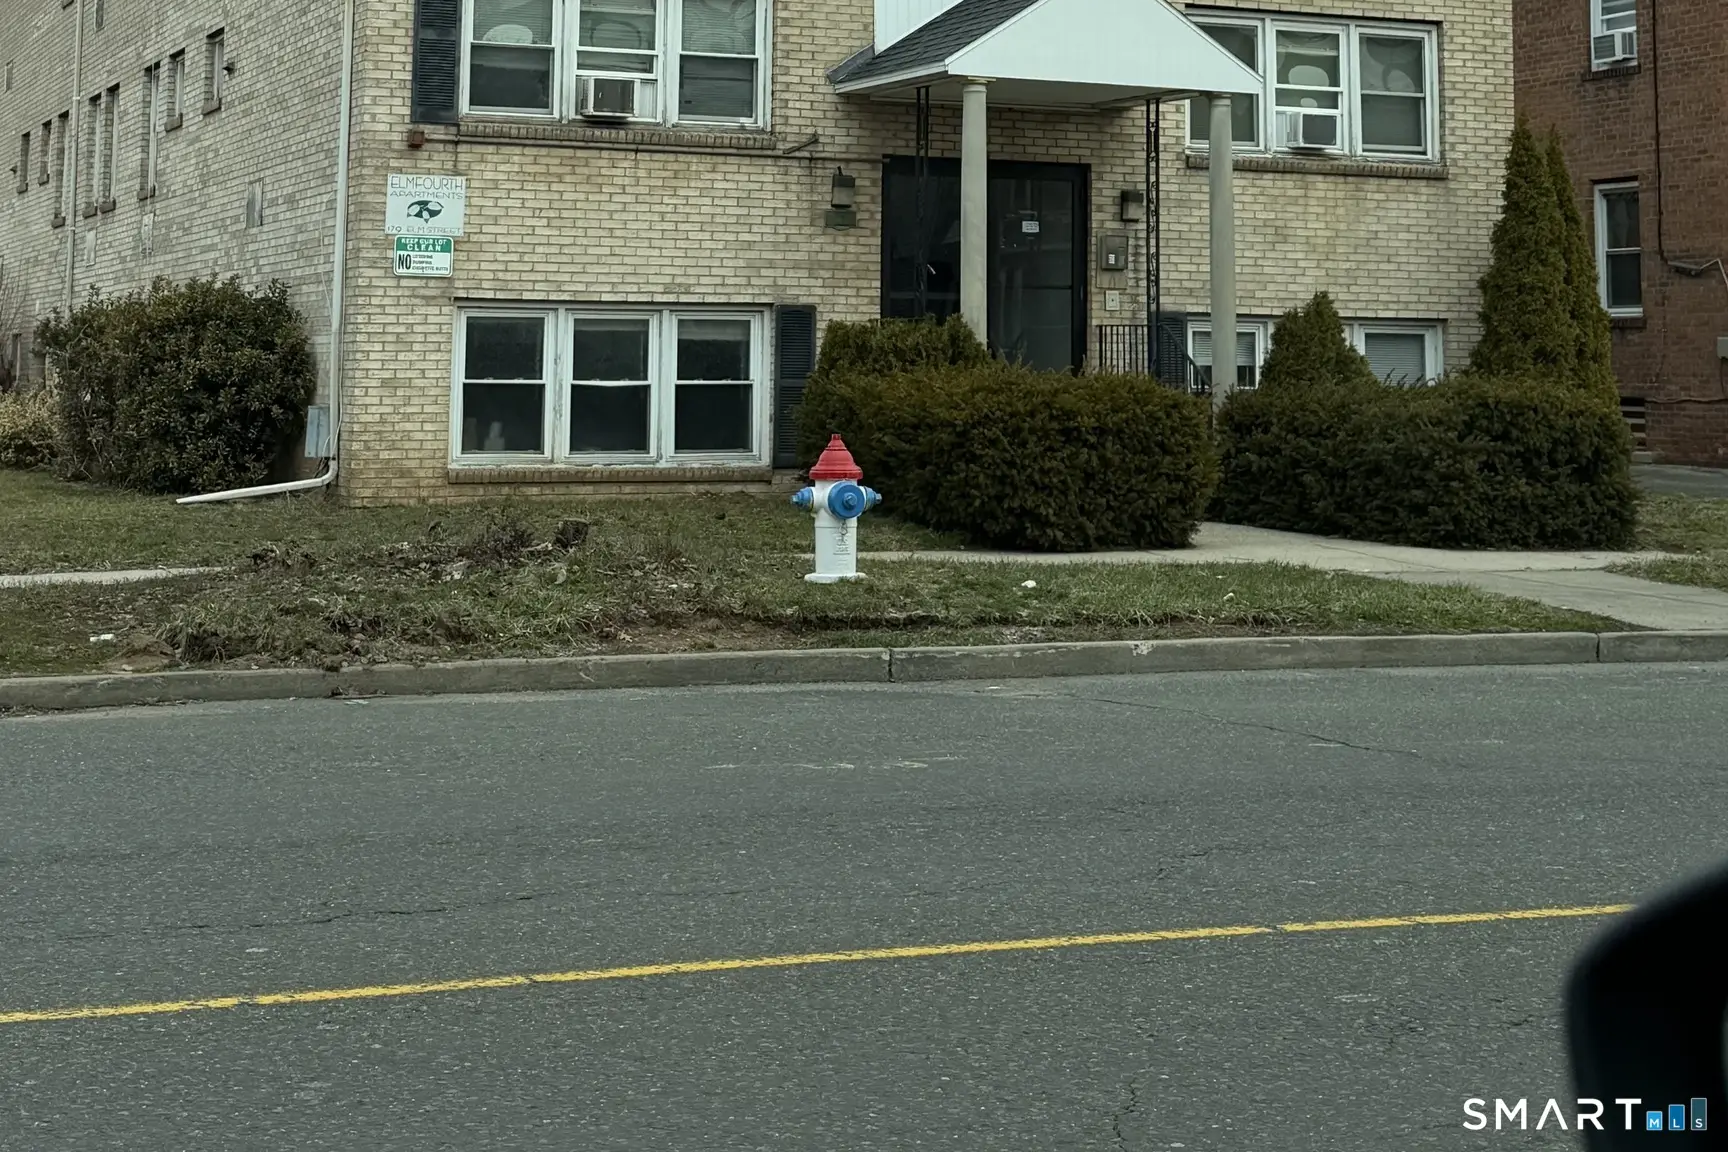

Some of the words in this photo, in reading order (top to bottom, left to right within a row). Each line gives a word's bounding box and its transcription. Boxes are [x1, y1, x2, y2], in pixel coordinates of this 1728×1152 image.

[391, 176, 463, 191] ELMFOURTH
[390, 190, 463, 200] APARTMENTS
[387, 225, 402, 233] 179
[398, 253, 412, 270] NO
